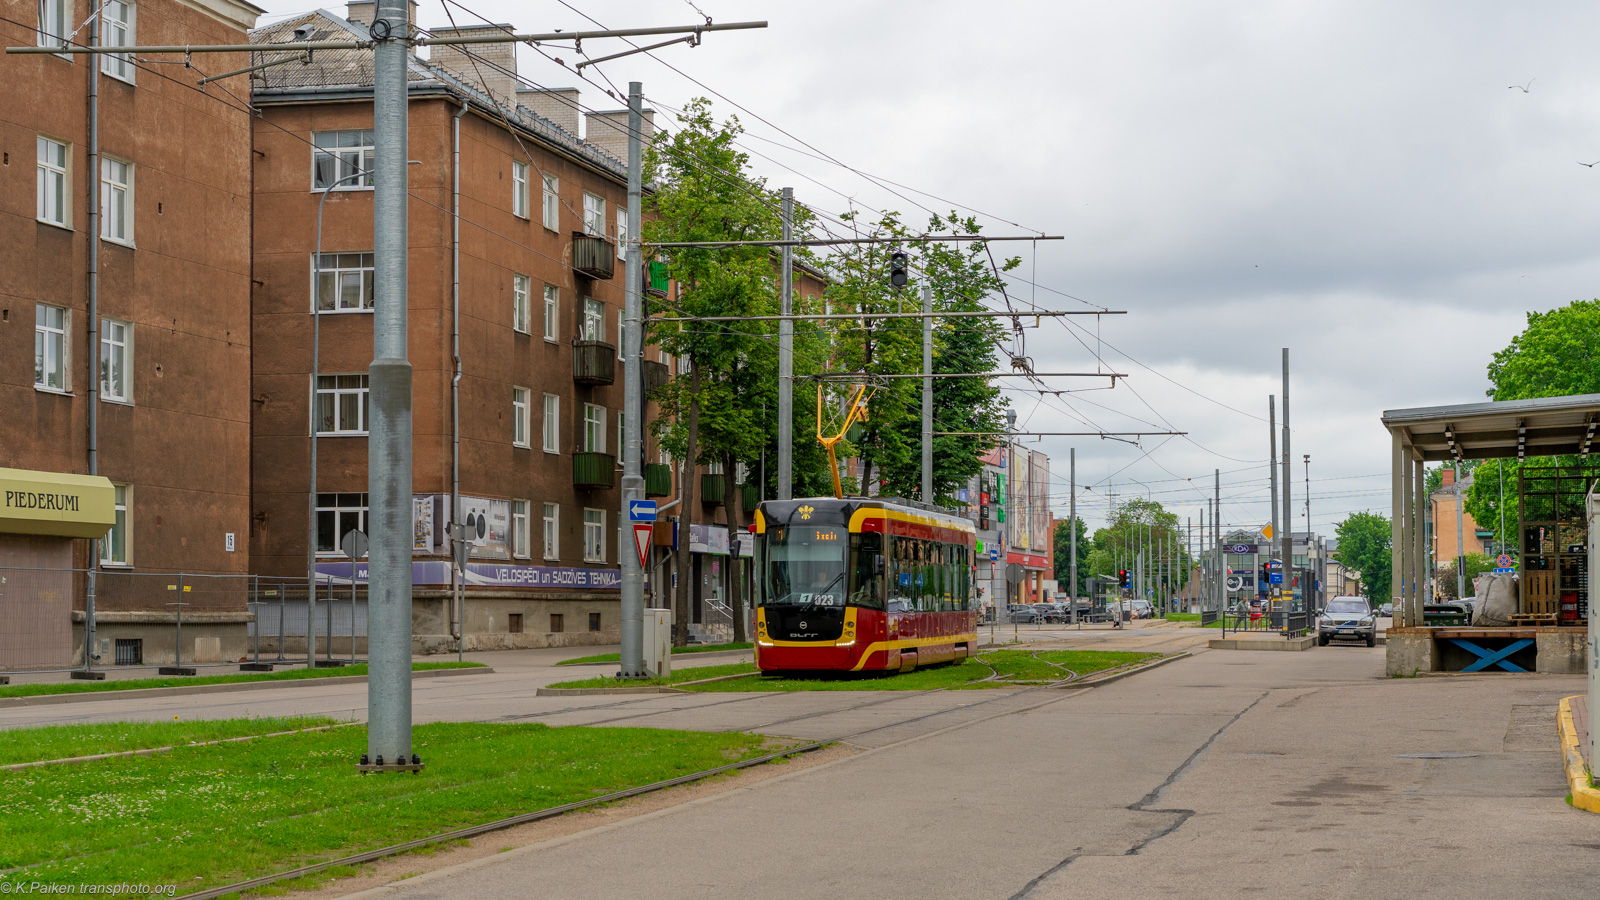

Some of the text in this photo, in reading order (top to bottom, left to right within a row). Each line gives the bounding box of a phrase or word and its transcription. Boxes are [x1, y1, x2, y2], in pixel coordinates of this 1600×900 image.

[6, 491, 79, 511] PIEDERUMI
[227, 535, 233, 546] 15
[495, 567, 539, 583] VELOSIPĒDI
[542, 573, 550, 583] un
[590, 572, 616, 585] TEHNIKA
